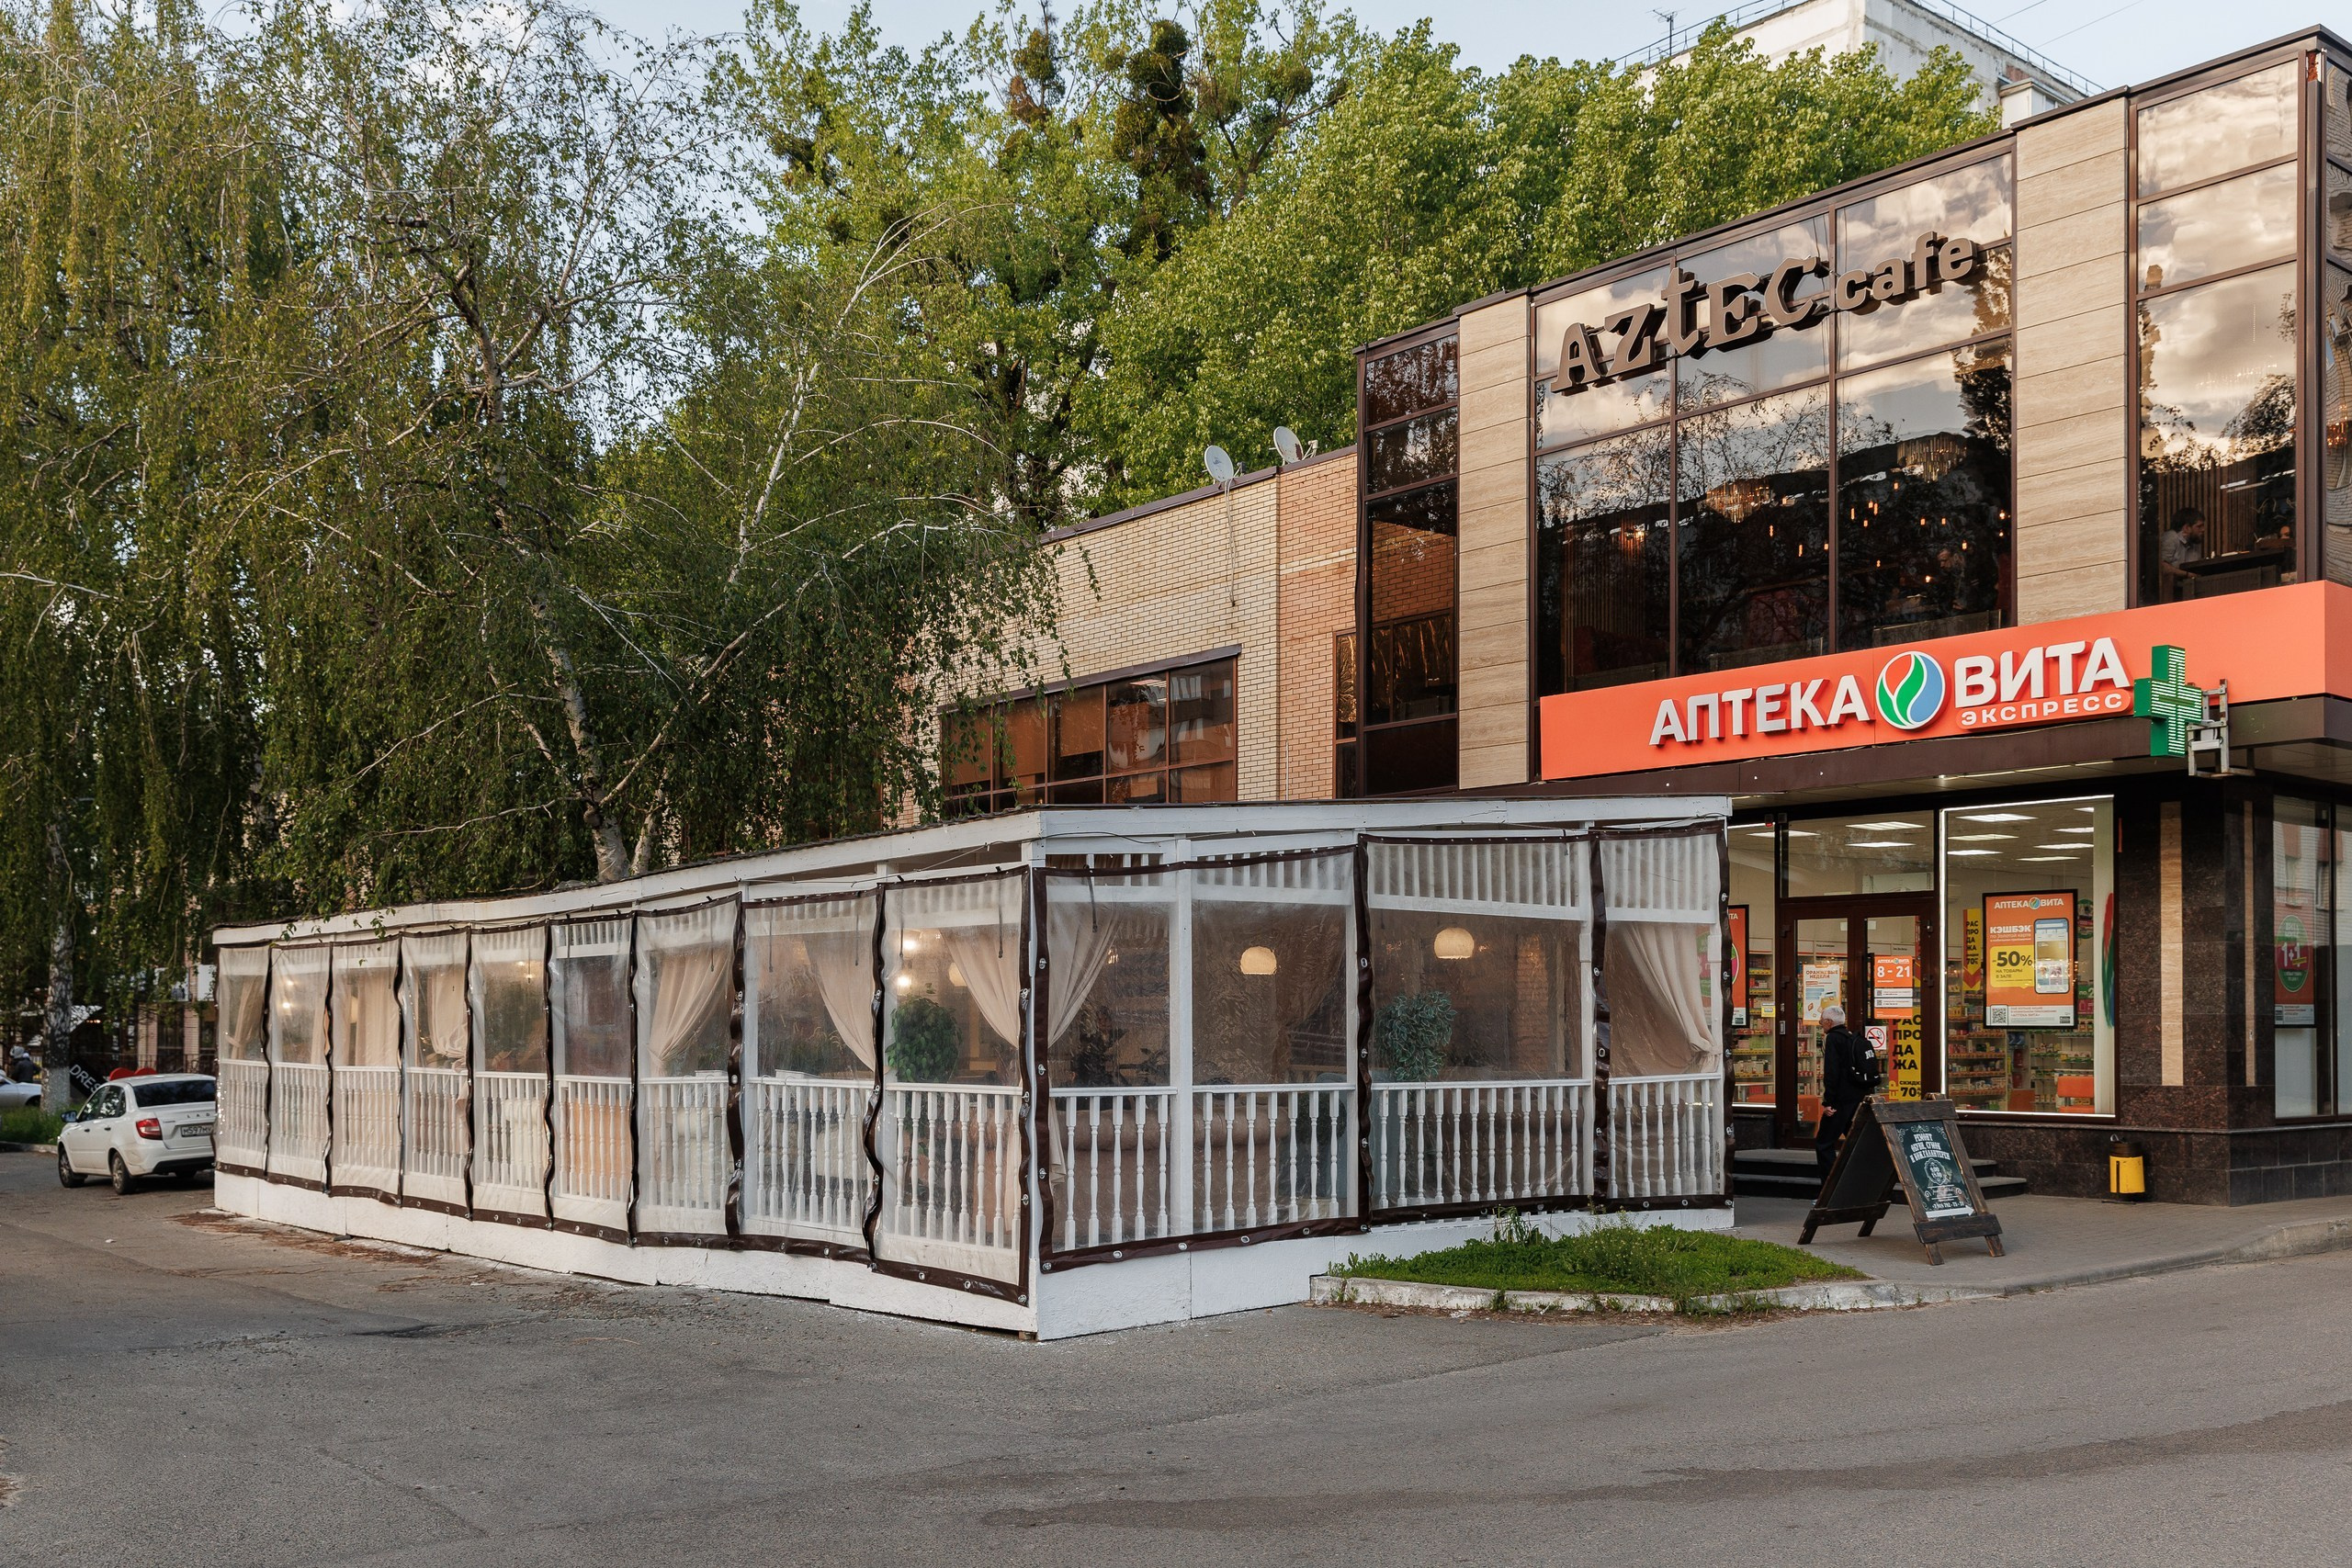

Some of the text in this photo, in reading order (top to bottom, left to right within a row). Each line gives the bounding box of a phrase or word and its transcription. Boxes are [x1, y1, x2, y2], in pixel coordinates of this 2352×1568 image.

[1836, 231, 1978, 311] cafe
[1649, 637, 2131, 747] АПТЕКА ВИТА
[1961, 692, 2124, 727] ЭКСПРЕСС
[1994, 897, 2064, 909] АПТЕКА ВИТА
[1989, 925, 2031, 934] КЭШБЭК
[1877, 965, 1885, 978] 8
[1895, 965, 1910, 978] 21
[1893, 1030, 1922, 1041] ПРО
[1893, 1044, 1915, 1056] ДА
[1893, 1059, 1918, 1070] ЖА
[70, 1064, 101, 1093] DRES
